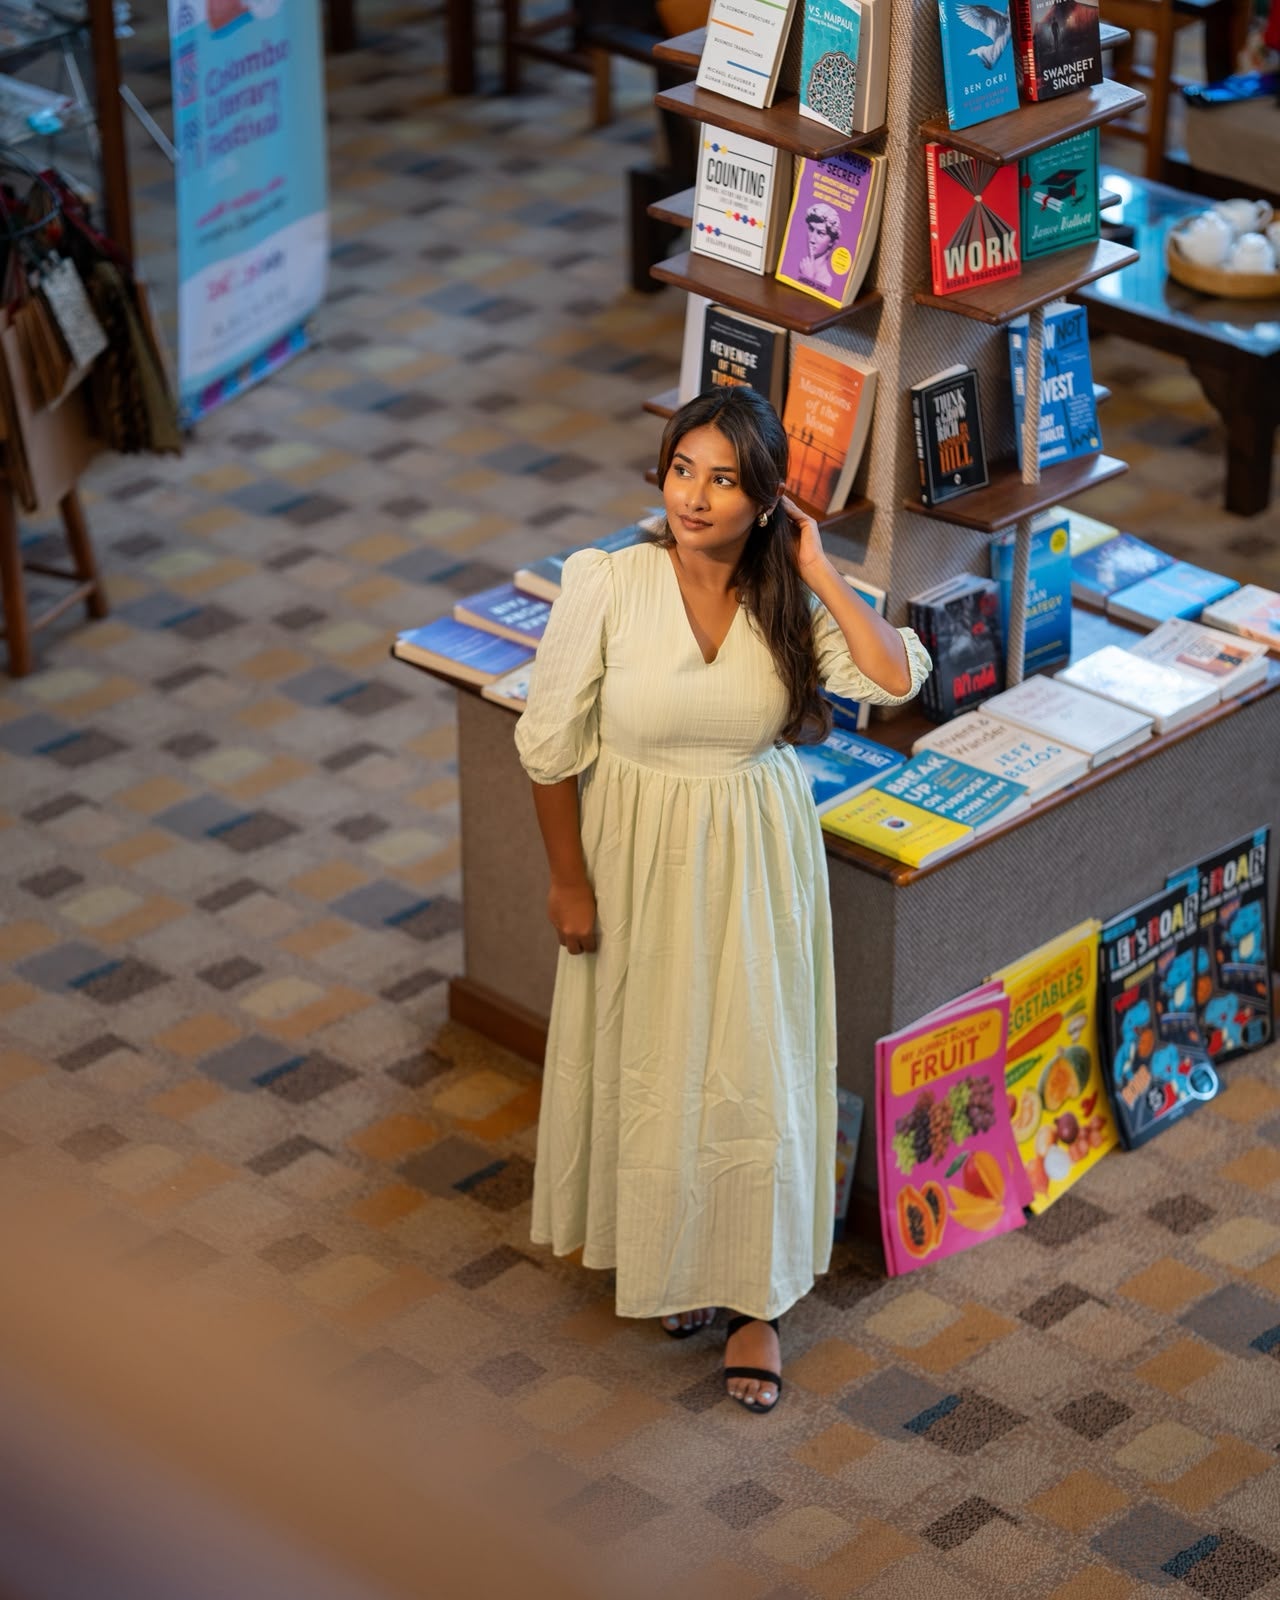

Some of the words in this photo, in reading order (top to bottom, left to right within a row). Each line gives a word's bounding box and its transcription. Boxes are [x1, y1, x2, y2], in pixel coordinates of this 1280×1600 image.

[824, 11, 853, 32] NAIPAUL
[964, 82, 981, 95] BEN
[985, 73, 1007, 87] OKRI
[1043, 57, 1094, 81] SWAPNEET
[1053, 72, 1085, 90] SINGH
[707, 158, 766, 198] COUNTING
[827, 163, 862, 186] SECRETS
[929, 201, 938, 225] WORK
[943, 231, 1019, 280] WORK
[710, 339, 758, 369] REVENGE
[717, 358, 729, 372] OF
[730, 362, 747, 379] THE
[799, 377, 853, 412] Mansions
[1040, 370, 1074, 406] VEST
[804, 412, 836, 438] Moon
[805, 399, 818, 415] of
[820, 405, 840, 423] the
[949, 724, 1008, 756] Wander
[994, 741, 1032, 767] JEFF
[884, 754, 949, 795] BREAK
[1004, 745, 1062, 778] BEZOS
[922, 793, 945, 808] ON
[953, 797, 987, 820] JOHN
[981, 780, 1009, 799] KIM
[1148, 894, 1199, 947] ROAR
[1008, 965, 1084, 1037] EGETABLES
[910, 1034, 981, 1088] FRUIT
